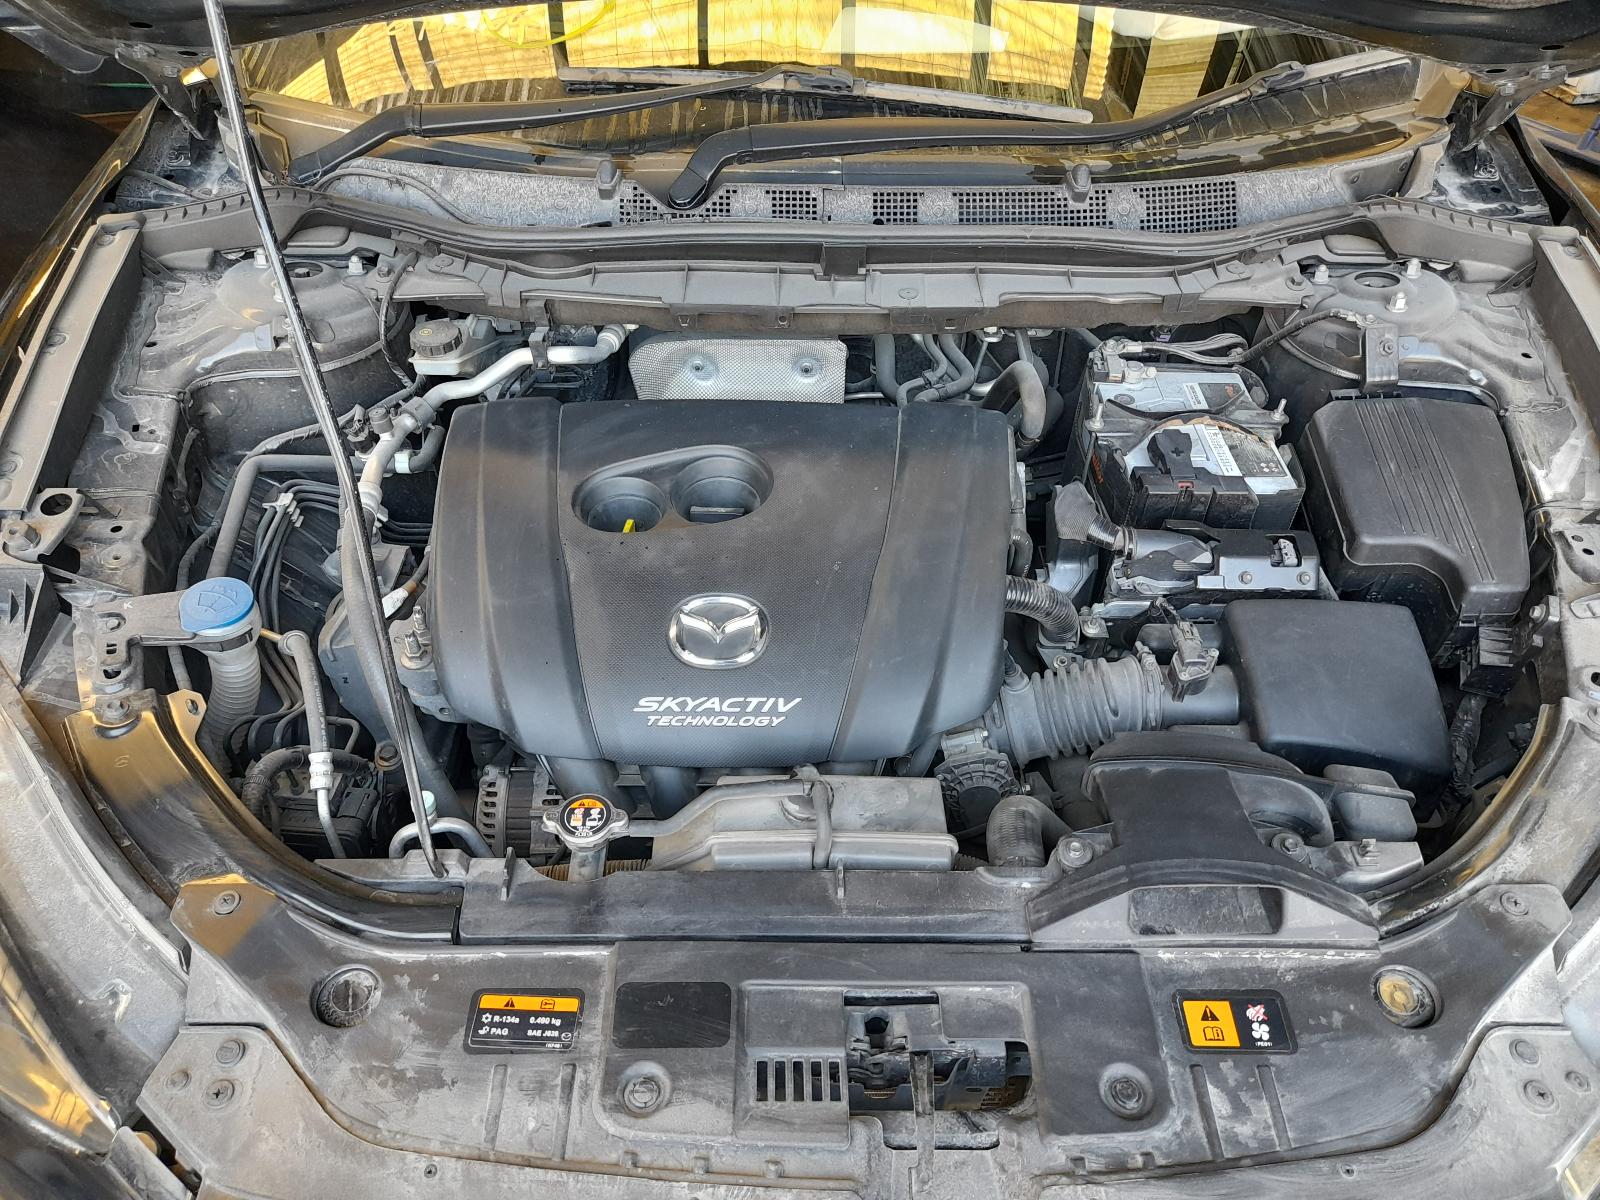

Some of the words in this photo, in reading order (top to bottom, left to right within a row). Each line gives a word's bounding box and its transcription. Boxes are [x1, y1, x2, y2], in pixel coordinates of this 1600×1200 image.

[633, 696, 802, 713] SKYACTIV
[647, 715, 786, 728] TECHNOLOGY
[493, 1014, 520, 1024] R-134a
[551, 1017, 562, 1027] kg
[490, 1027, 509, 1036] PAG
[526, 1029, 543, 1037] SAE
